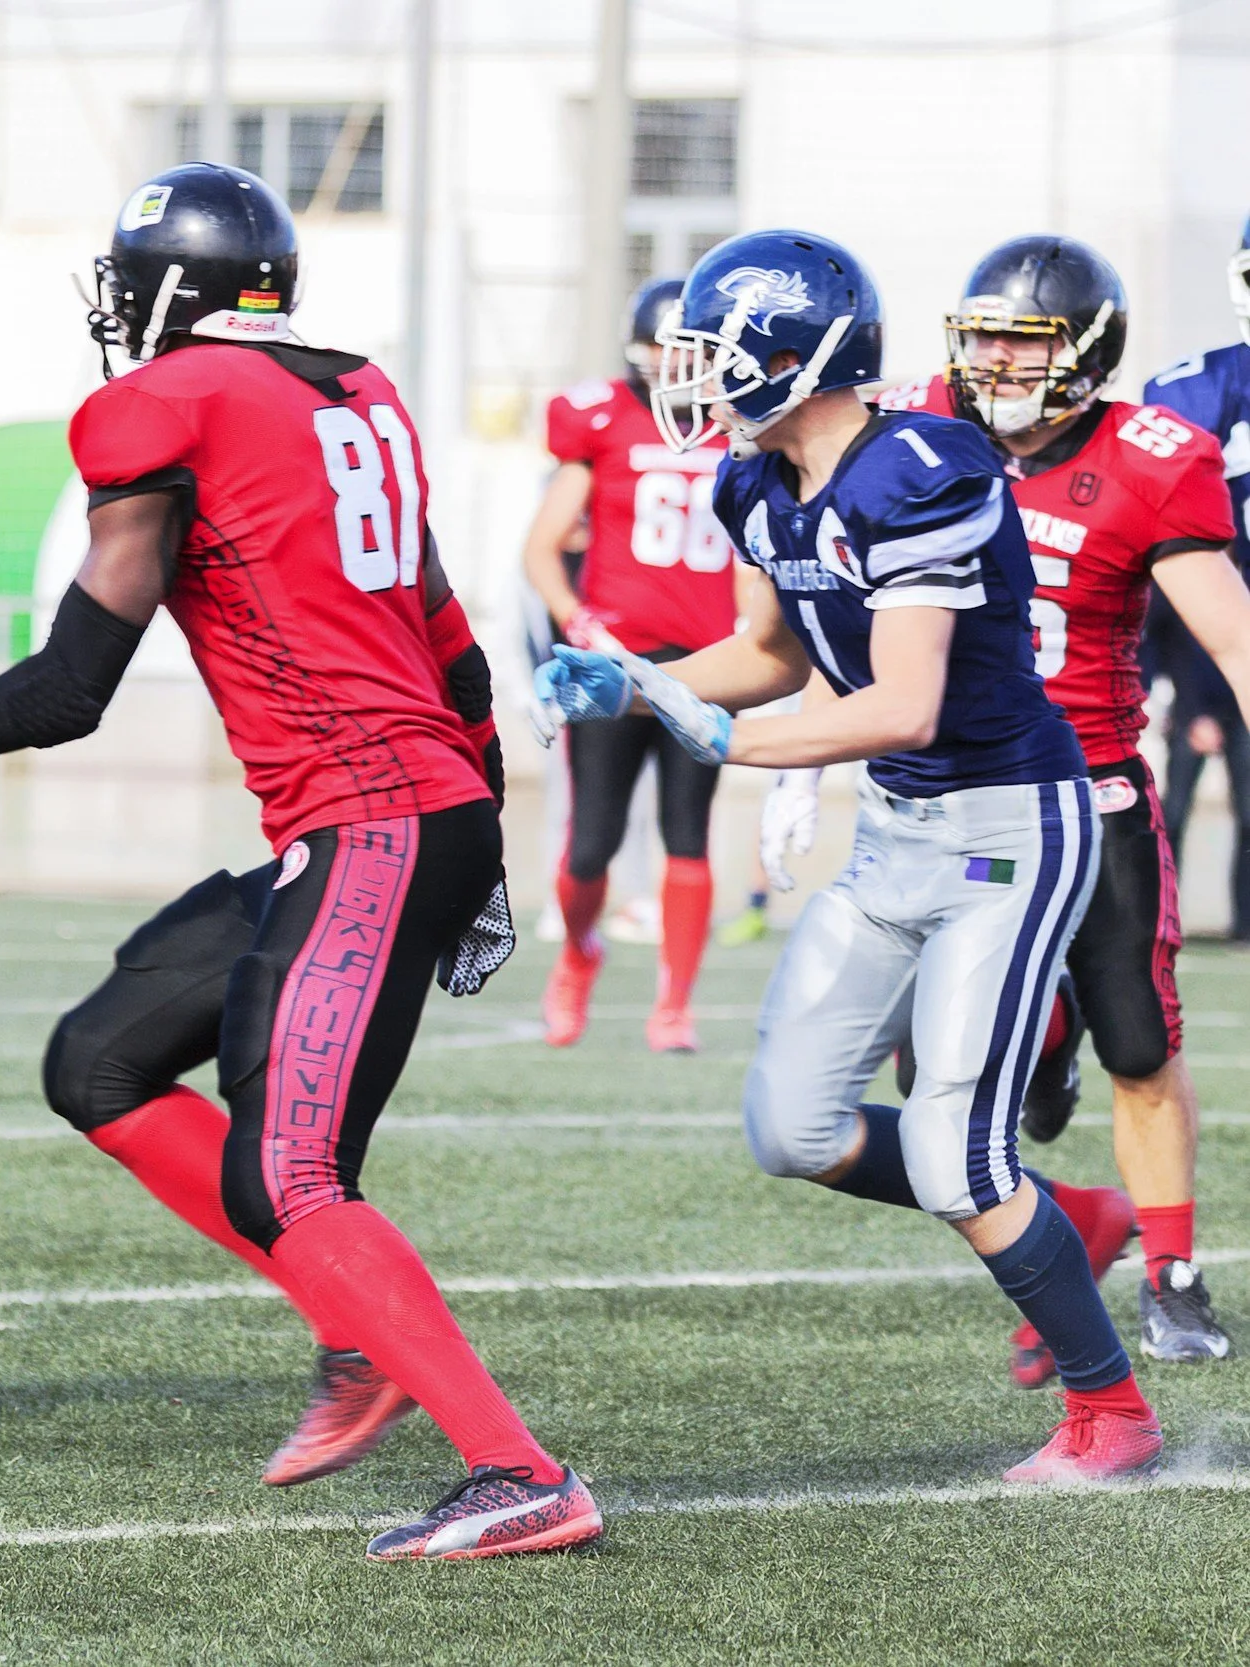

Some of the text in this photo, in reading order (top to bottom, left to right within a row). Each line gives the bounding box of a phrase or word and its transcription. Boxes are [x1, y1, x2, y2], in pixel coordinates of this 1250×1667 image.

[893, 428, 943, 468] 1
[1117, 406, 1193, 459] 55
[313, 404, 421, 593] 81
[798, 600, 859, 693] 1
[1028, 553, 1071, 678] 5
